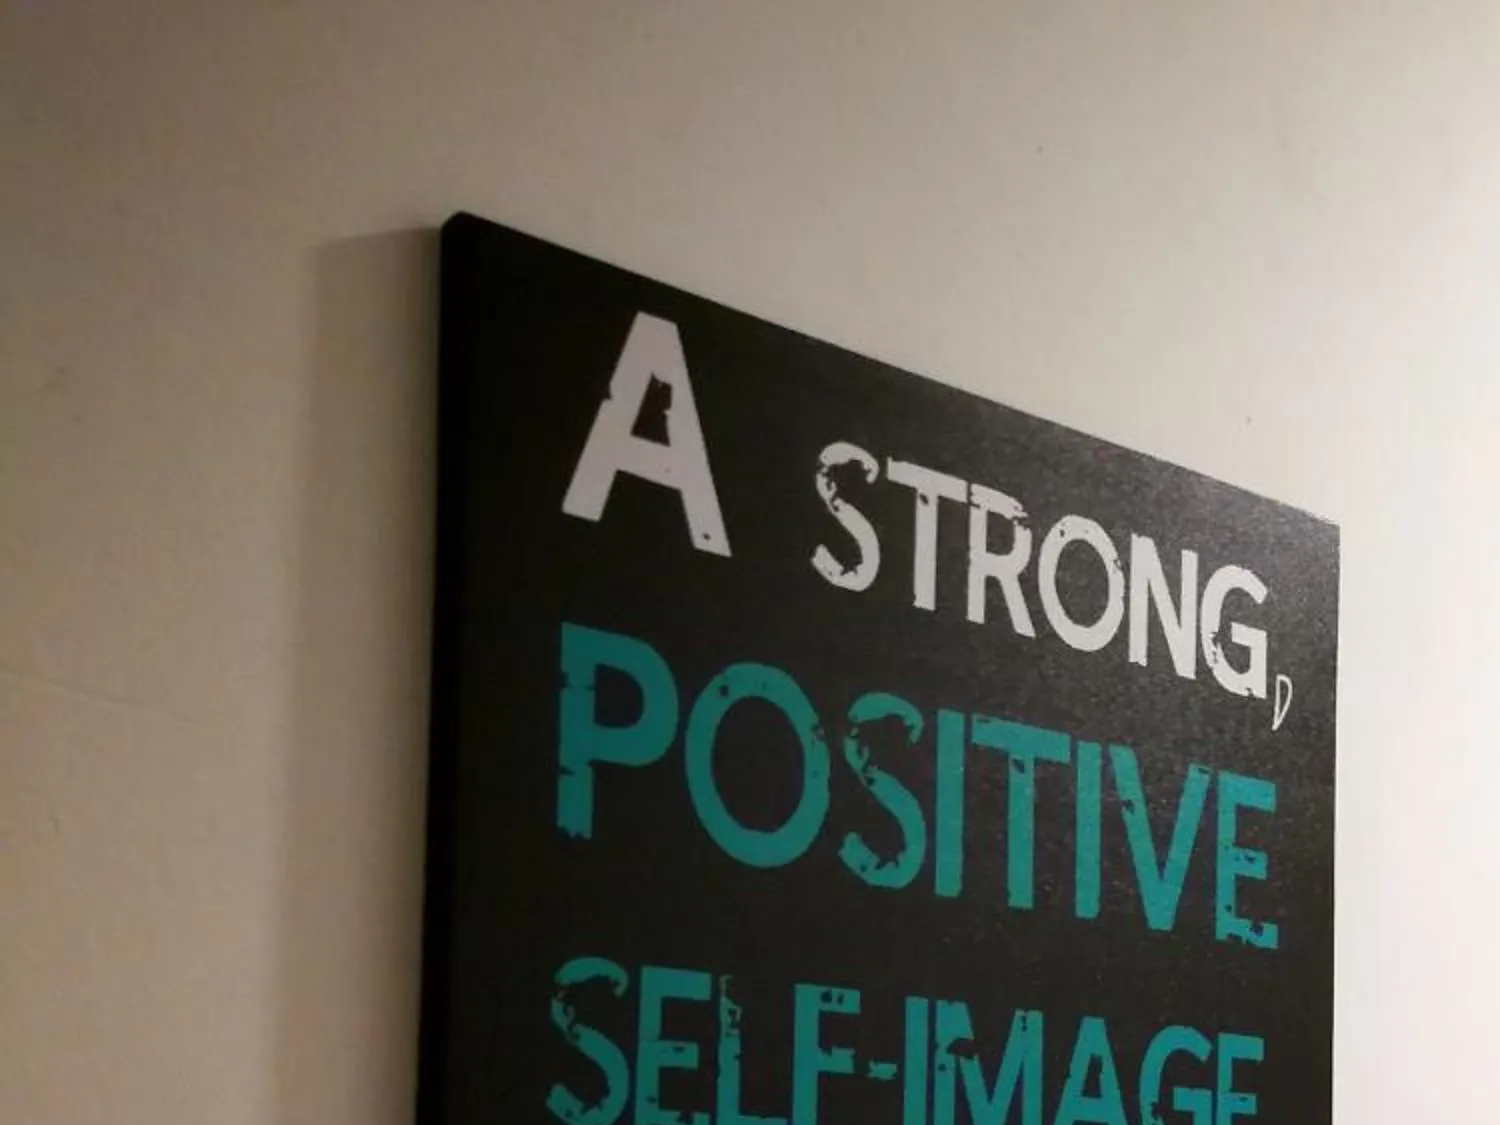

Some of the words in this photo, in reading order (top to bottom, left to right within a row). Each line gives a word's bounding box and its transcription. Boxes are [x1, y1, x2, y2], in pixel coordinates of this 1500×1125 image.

[562, 311, 732, 557] A
[811, 441, 1293, 731] STRONG,
[555, 620, 1279, 949] POSITIVE
